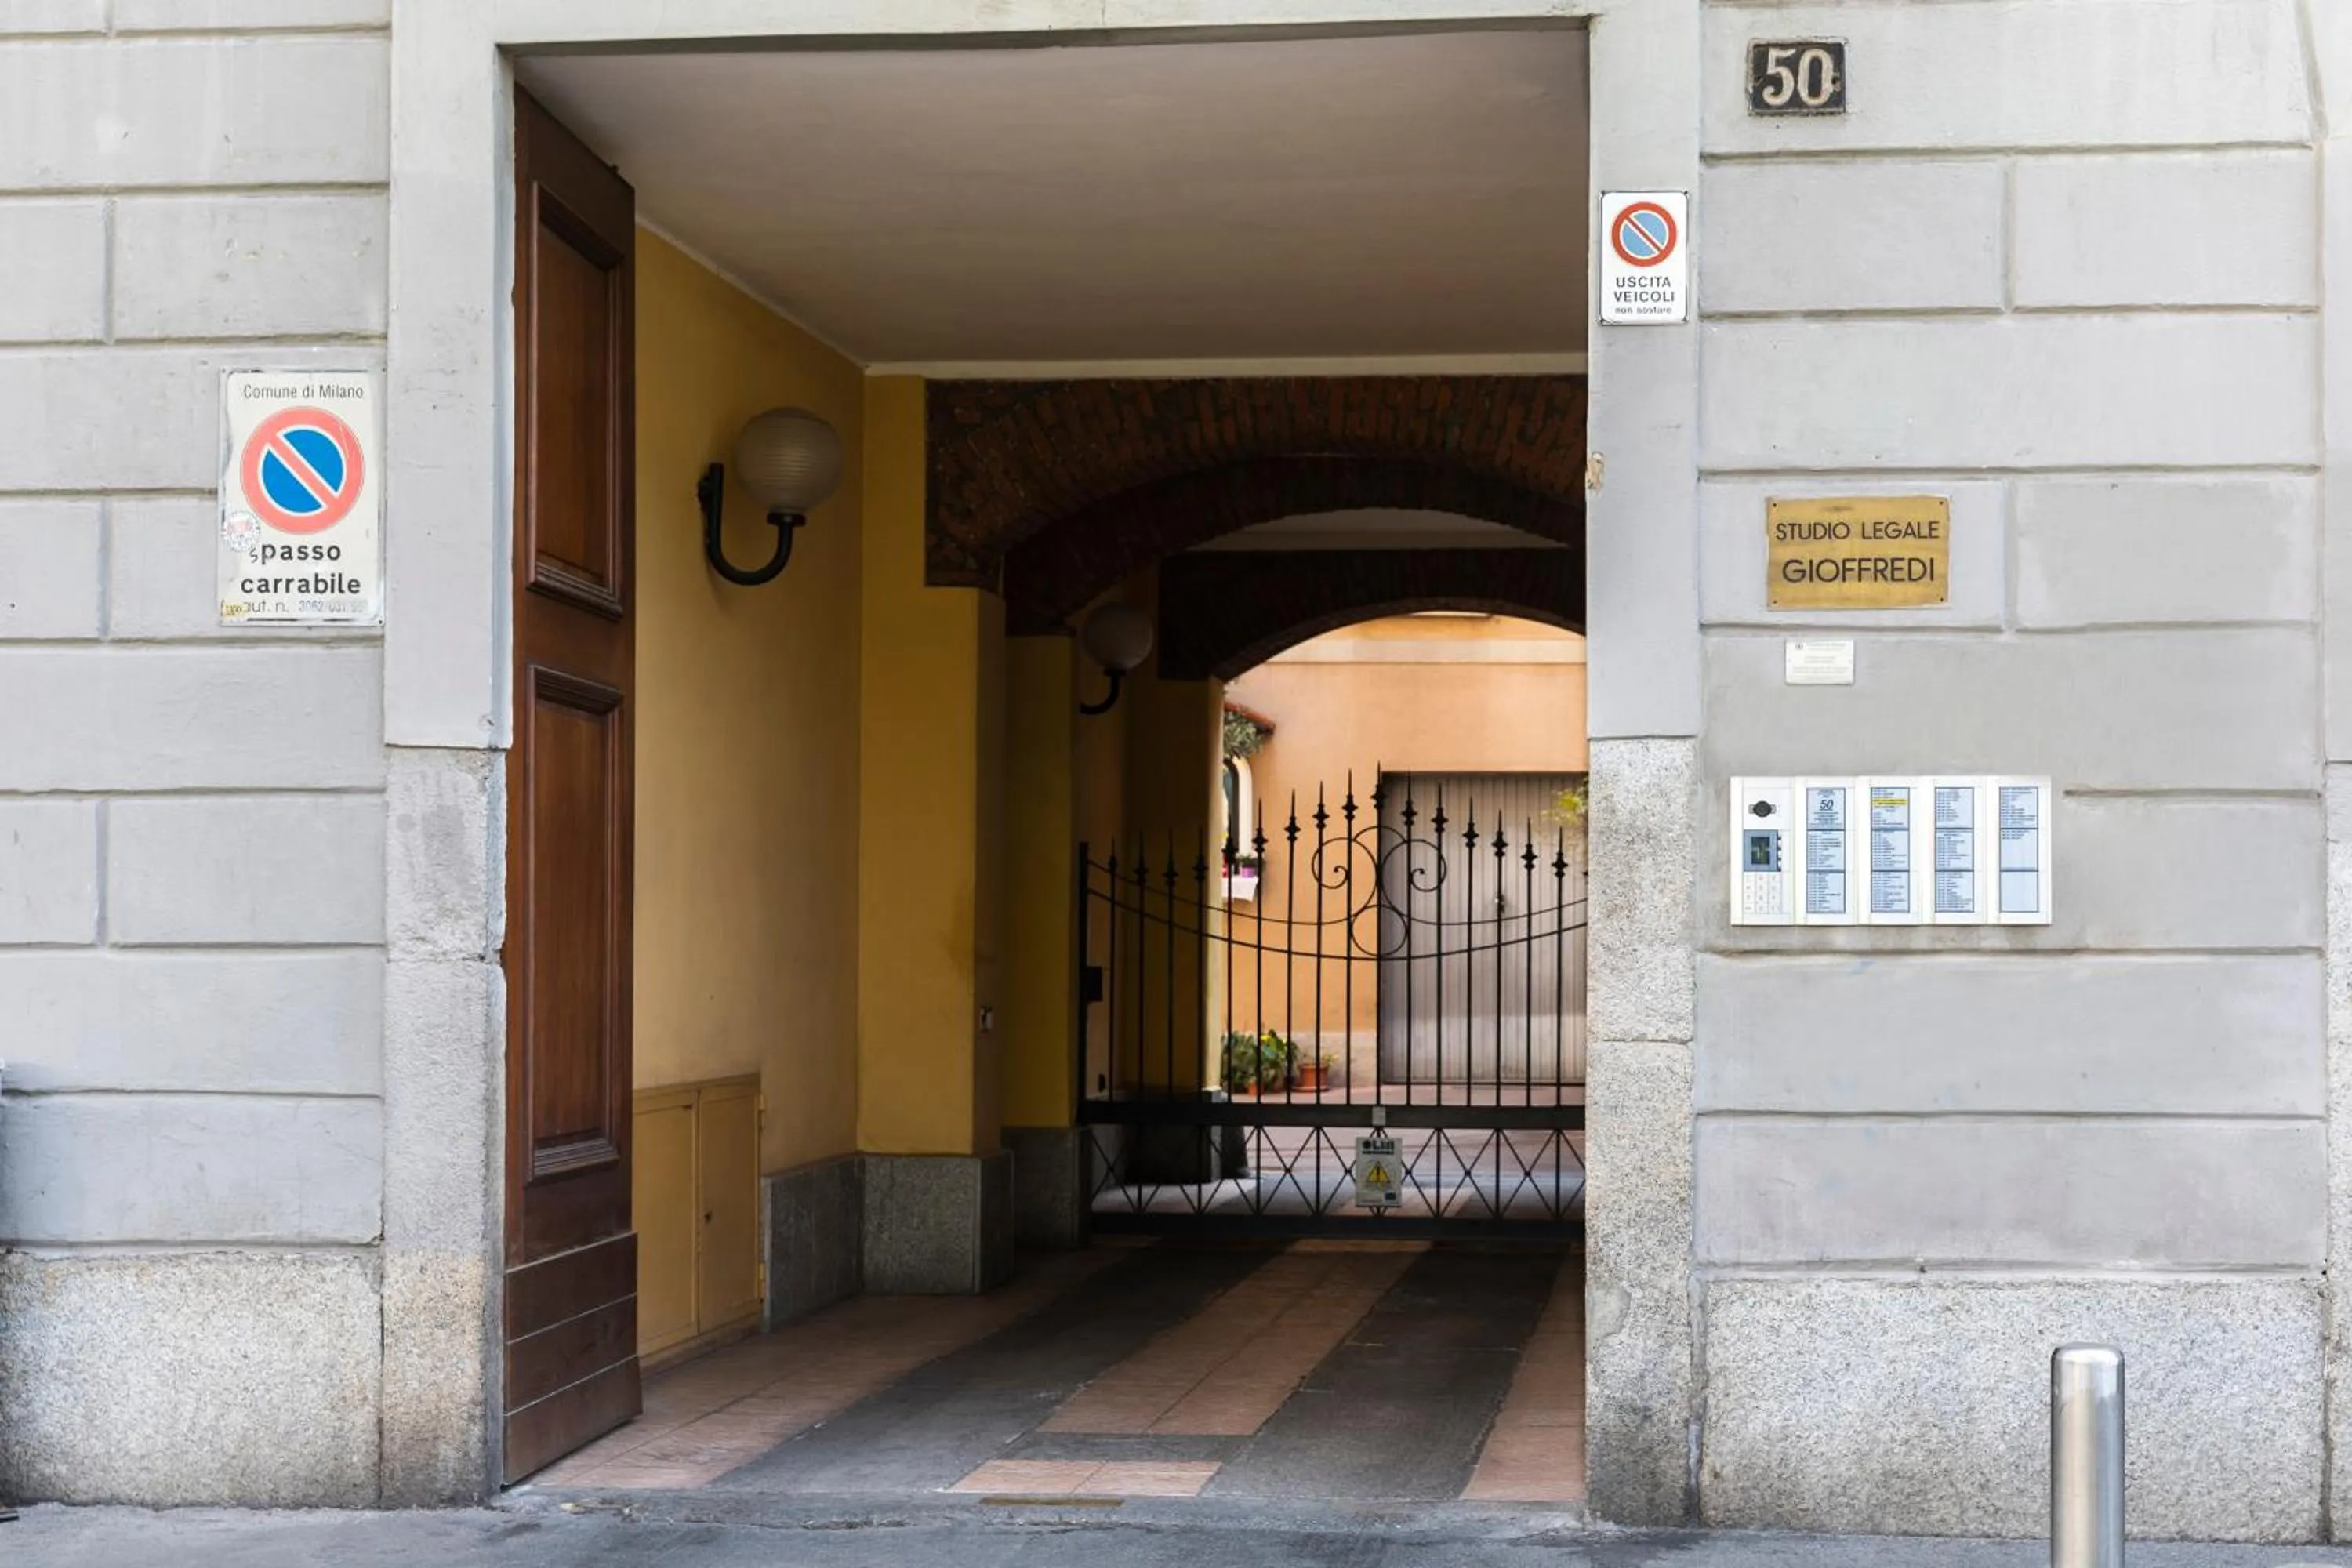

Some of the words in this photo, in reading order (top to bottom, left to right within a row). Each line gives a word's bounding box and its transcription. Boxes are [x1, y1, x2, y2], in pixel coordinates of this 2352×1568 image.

[1762, 47, 1834, 107] 50
[1615, 276, 1671, 288] USCITA
[1613, 291, 1675, 303] VEICOLI
[1636, 306, 1672, 314] sostare
[243, 383, 297, 399] Comune
[302, 383, 314, 399] di
[318, 383, 364, 399] Milano
[1775, 521, 1850, 541] STUDIO
[1861, 520, 1940, 540] LEGALE
[1782, 557, 1934, 583] GIOFFREDI
[240, 572, 361, 594] carrabile
[275, 601, 289, 613] n.
